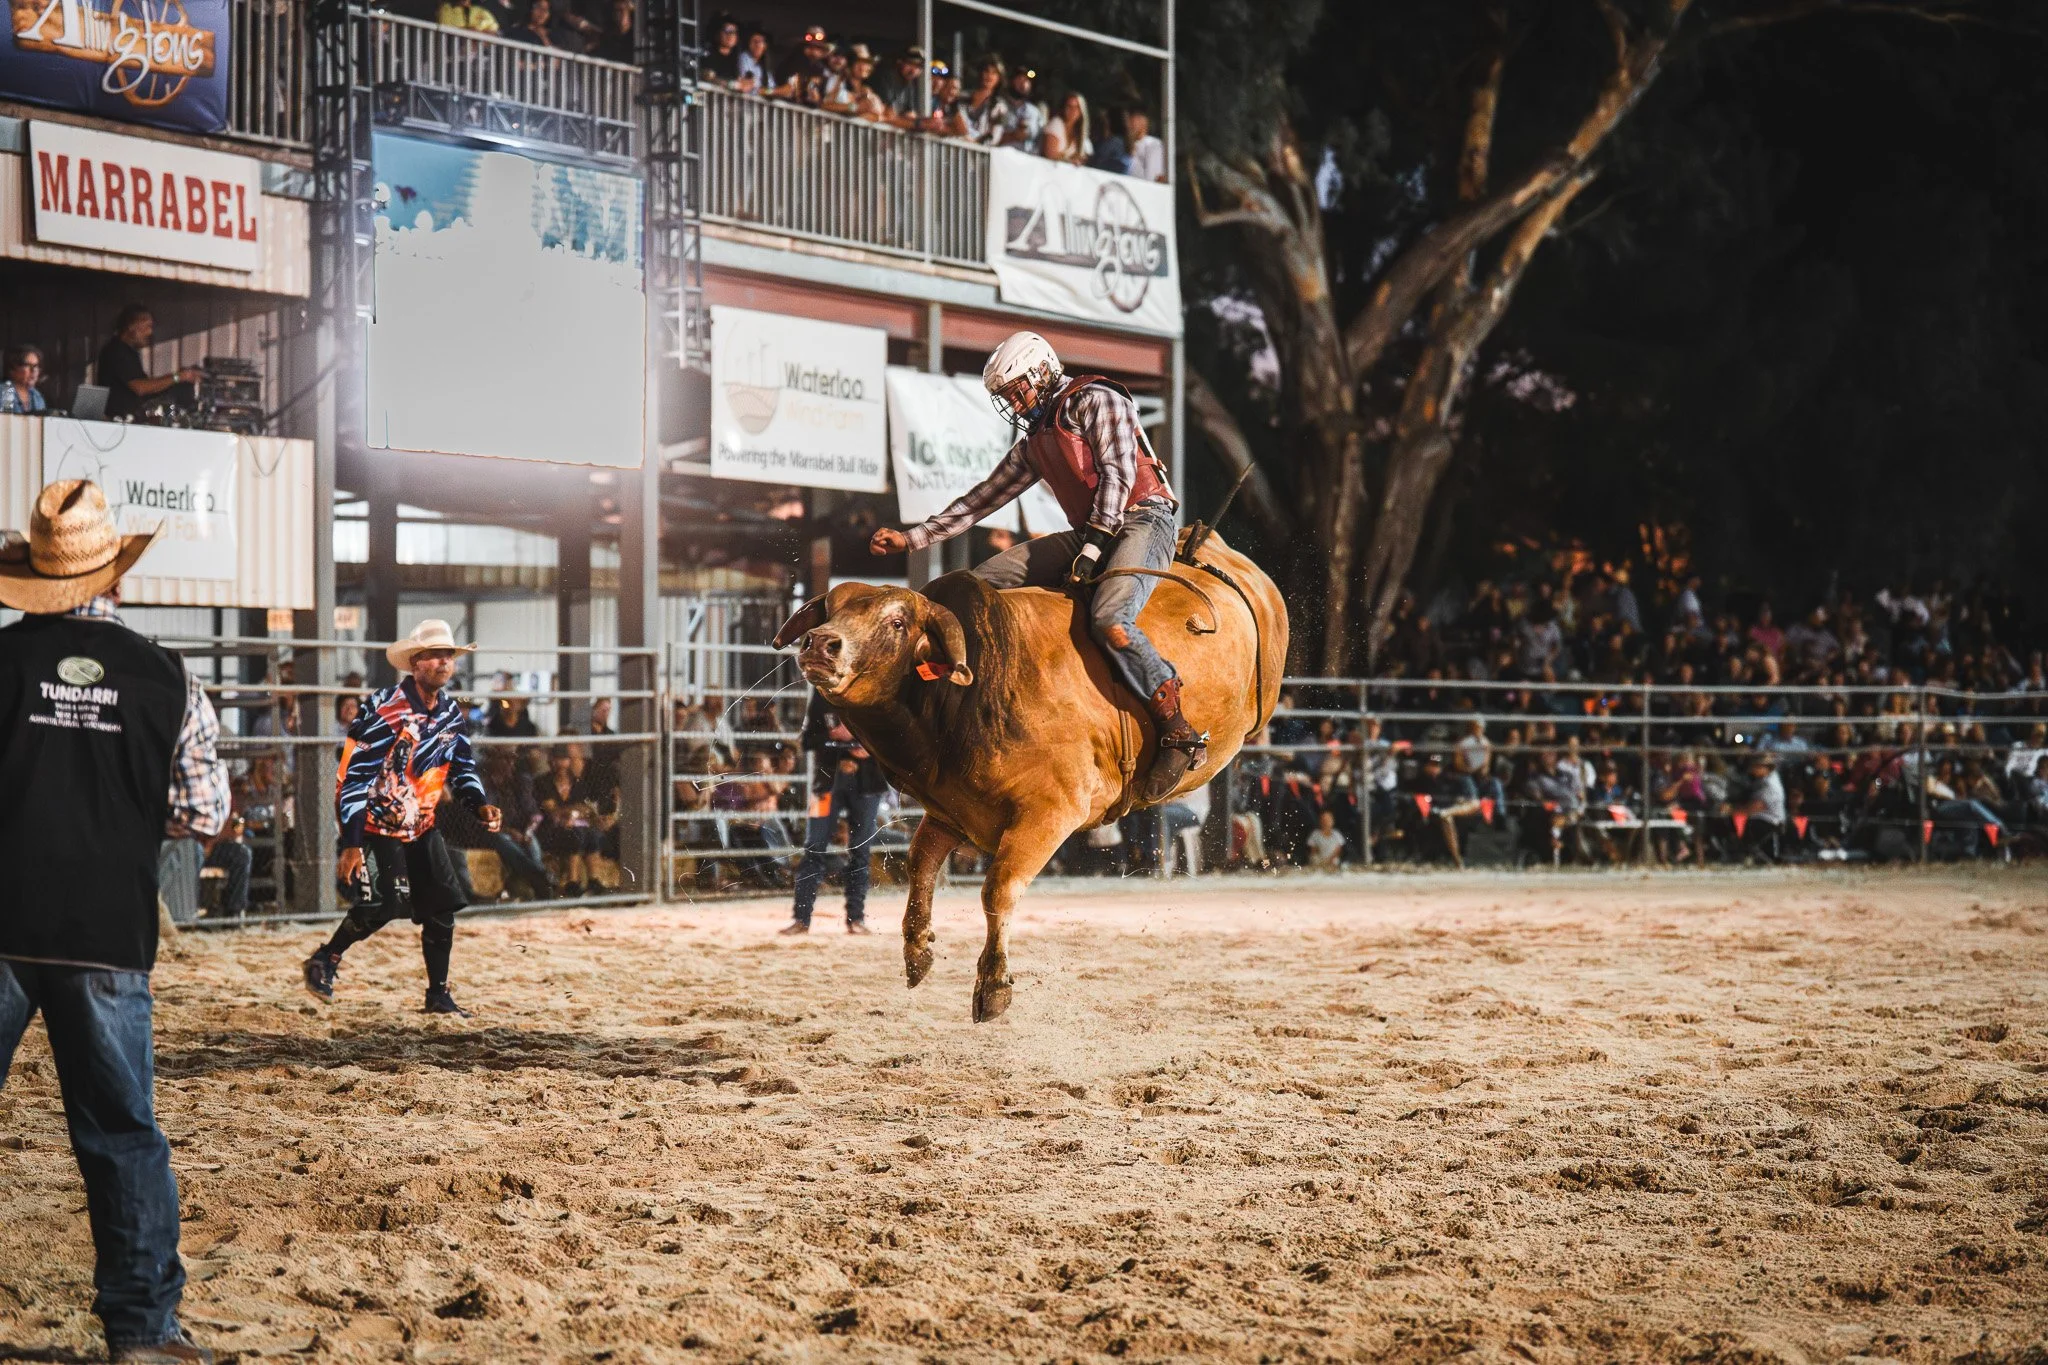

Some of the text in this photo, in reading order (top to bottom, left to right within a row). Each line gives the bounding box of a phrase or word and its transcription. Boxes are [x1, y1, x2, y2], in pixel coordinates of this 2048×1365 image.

[38, 151, 258, 242] MARRABEL
[784, 361, 864, 400] Waterloo
[718, 441, 879, 477] Powering the Marrabel Bull Ride
[40, 681, 119, 706] TUNDARRI
